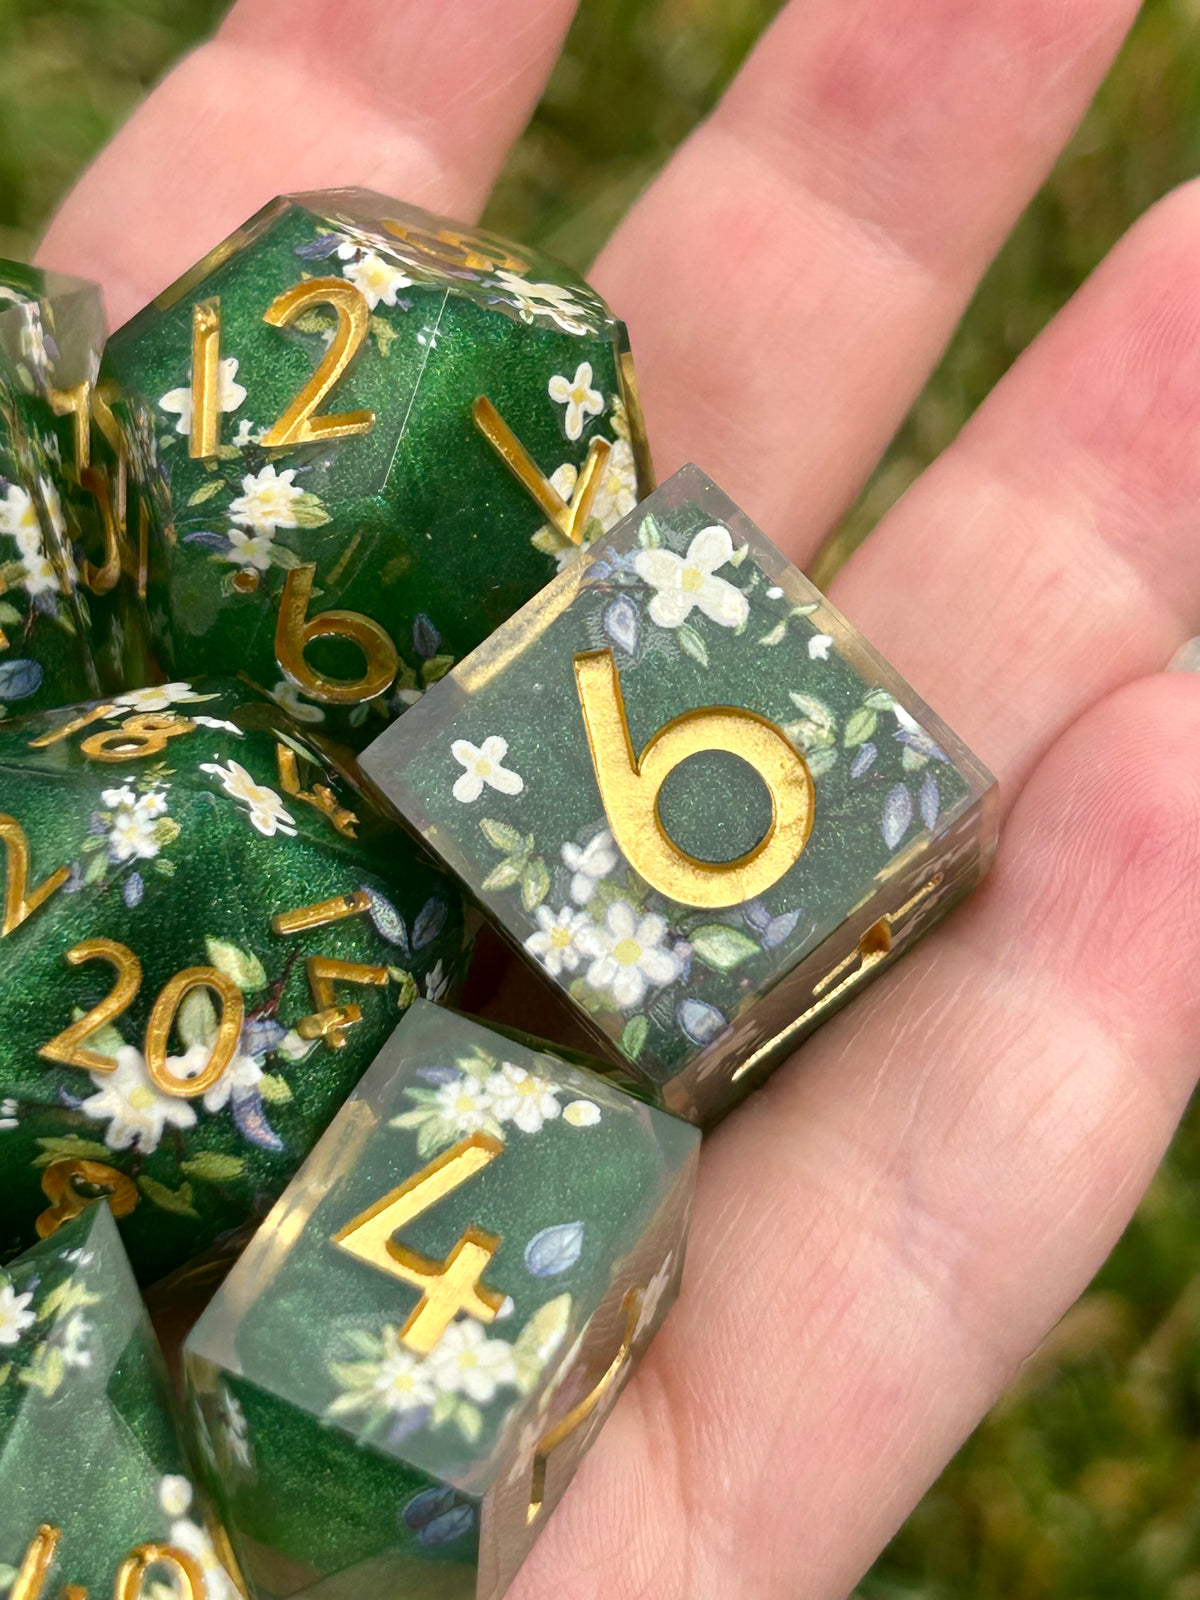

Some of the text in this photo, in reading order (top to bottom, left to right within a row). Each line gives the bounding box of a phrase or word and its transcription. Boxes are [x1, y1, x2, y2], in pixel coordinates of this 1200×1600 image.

[188, 275, 376, 461] 12
[27, 704, 197, 763] 18
[573, 647, 816, 909] 6
[38, 937, 245, 1099] 20
[331, 1131, 506, 1357] 4
